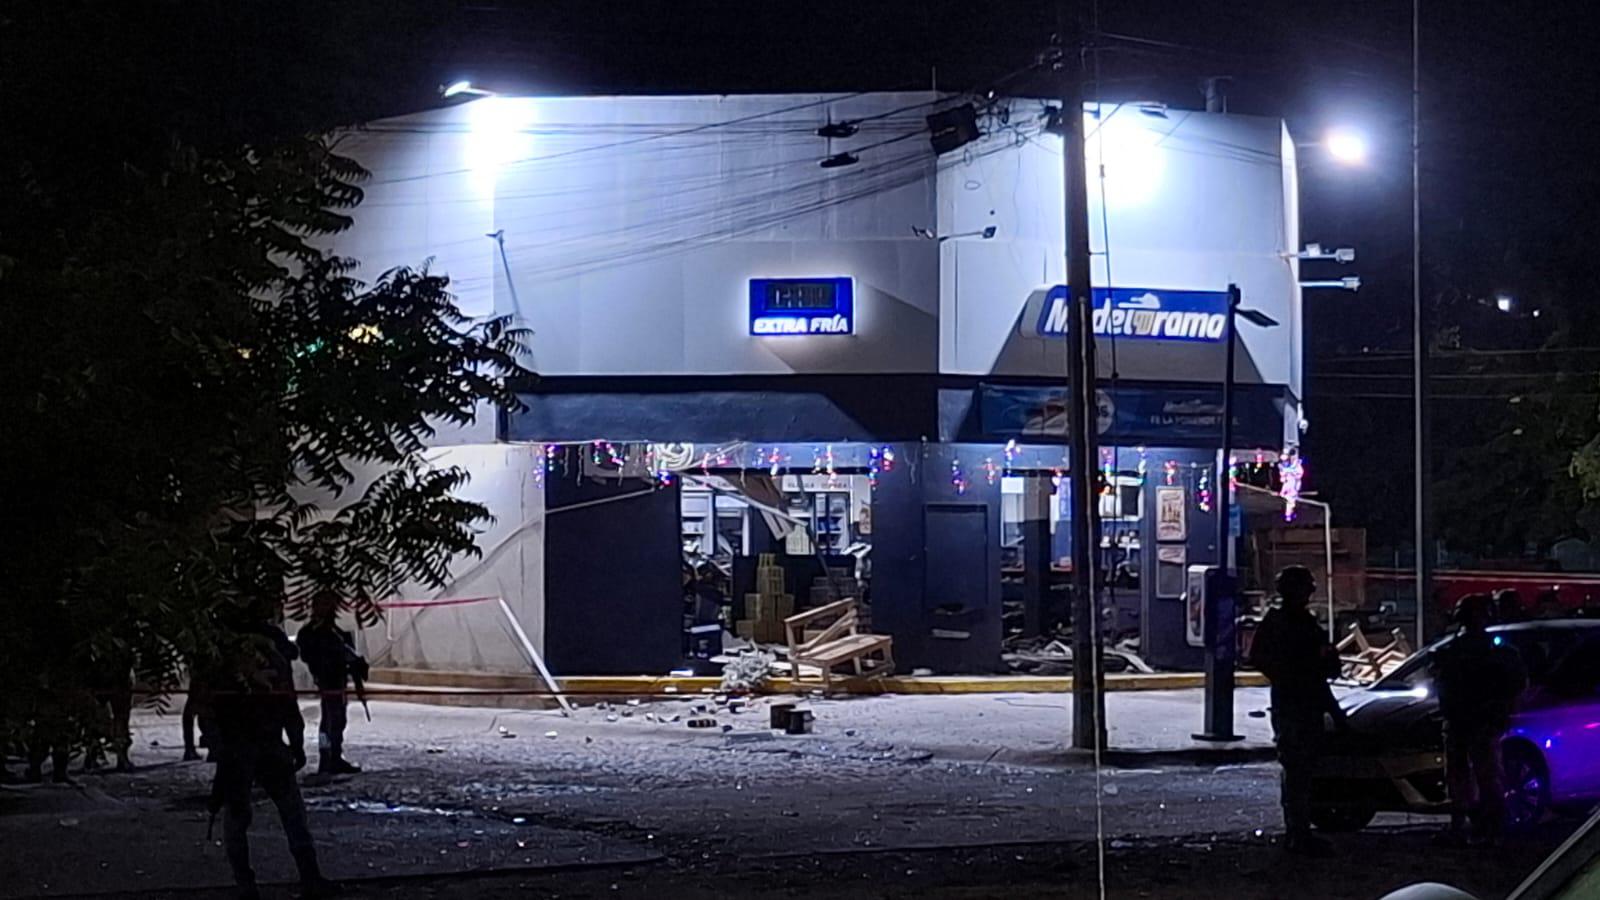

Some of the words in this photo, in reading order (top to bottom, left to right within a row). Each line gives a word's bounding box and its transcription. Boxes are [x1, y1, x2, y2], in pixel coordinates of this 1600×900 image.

[754, 317, 807, 333] EXTRA
[810, 314, 848, 332] FRÍA
[1044, 297, 1226, 338] Mdelorama
